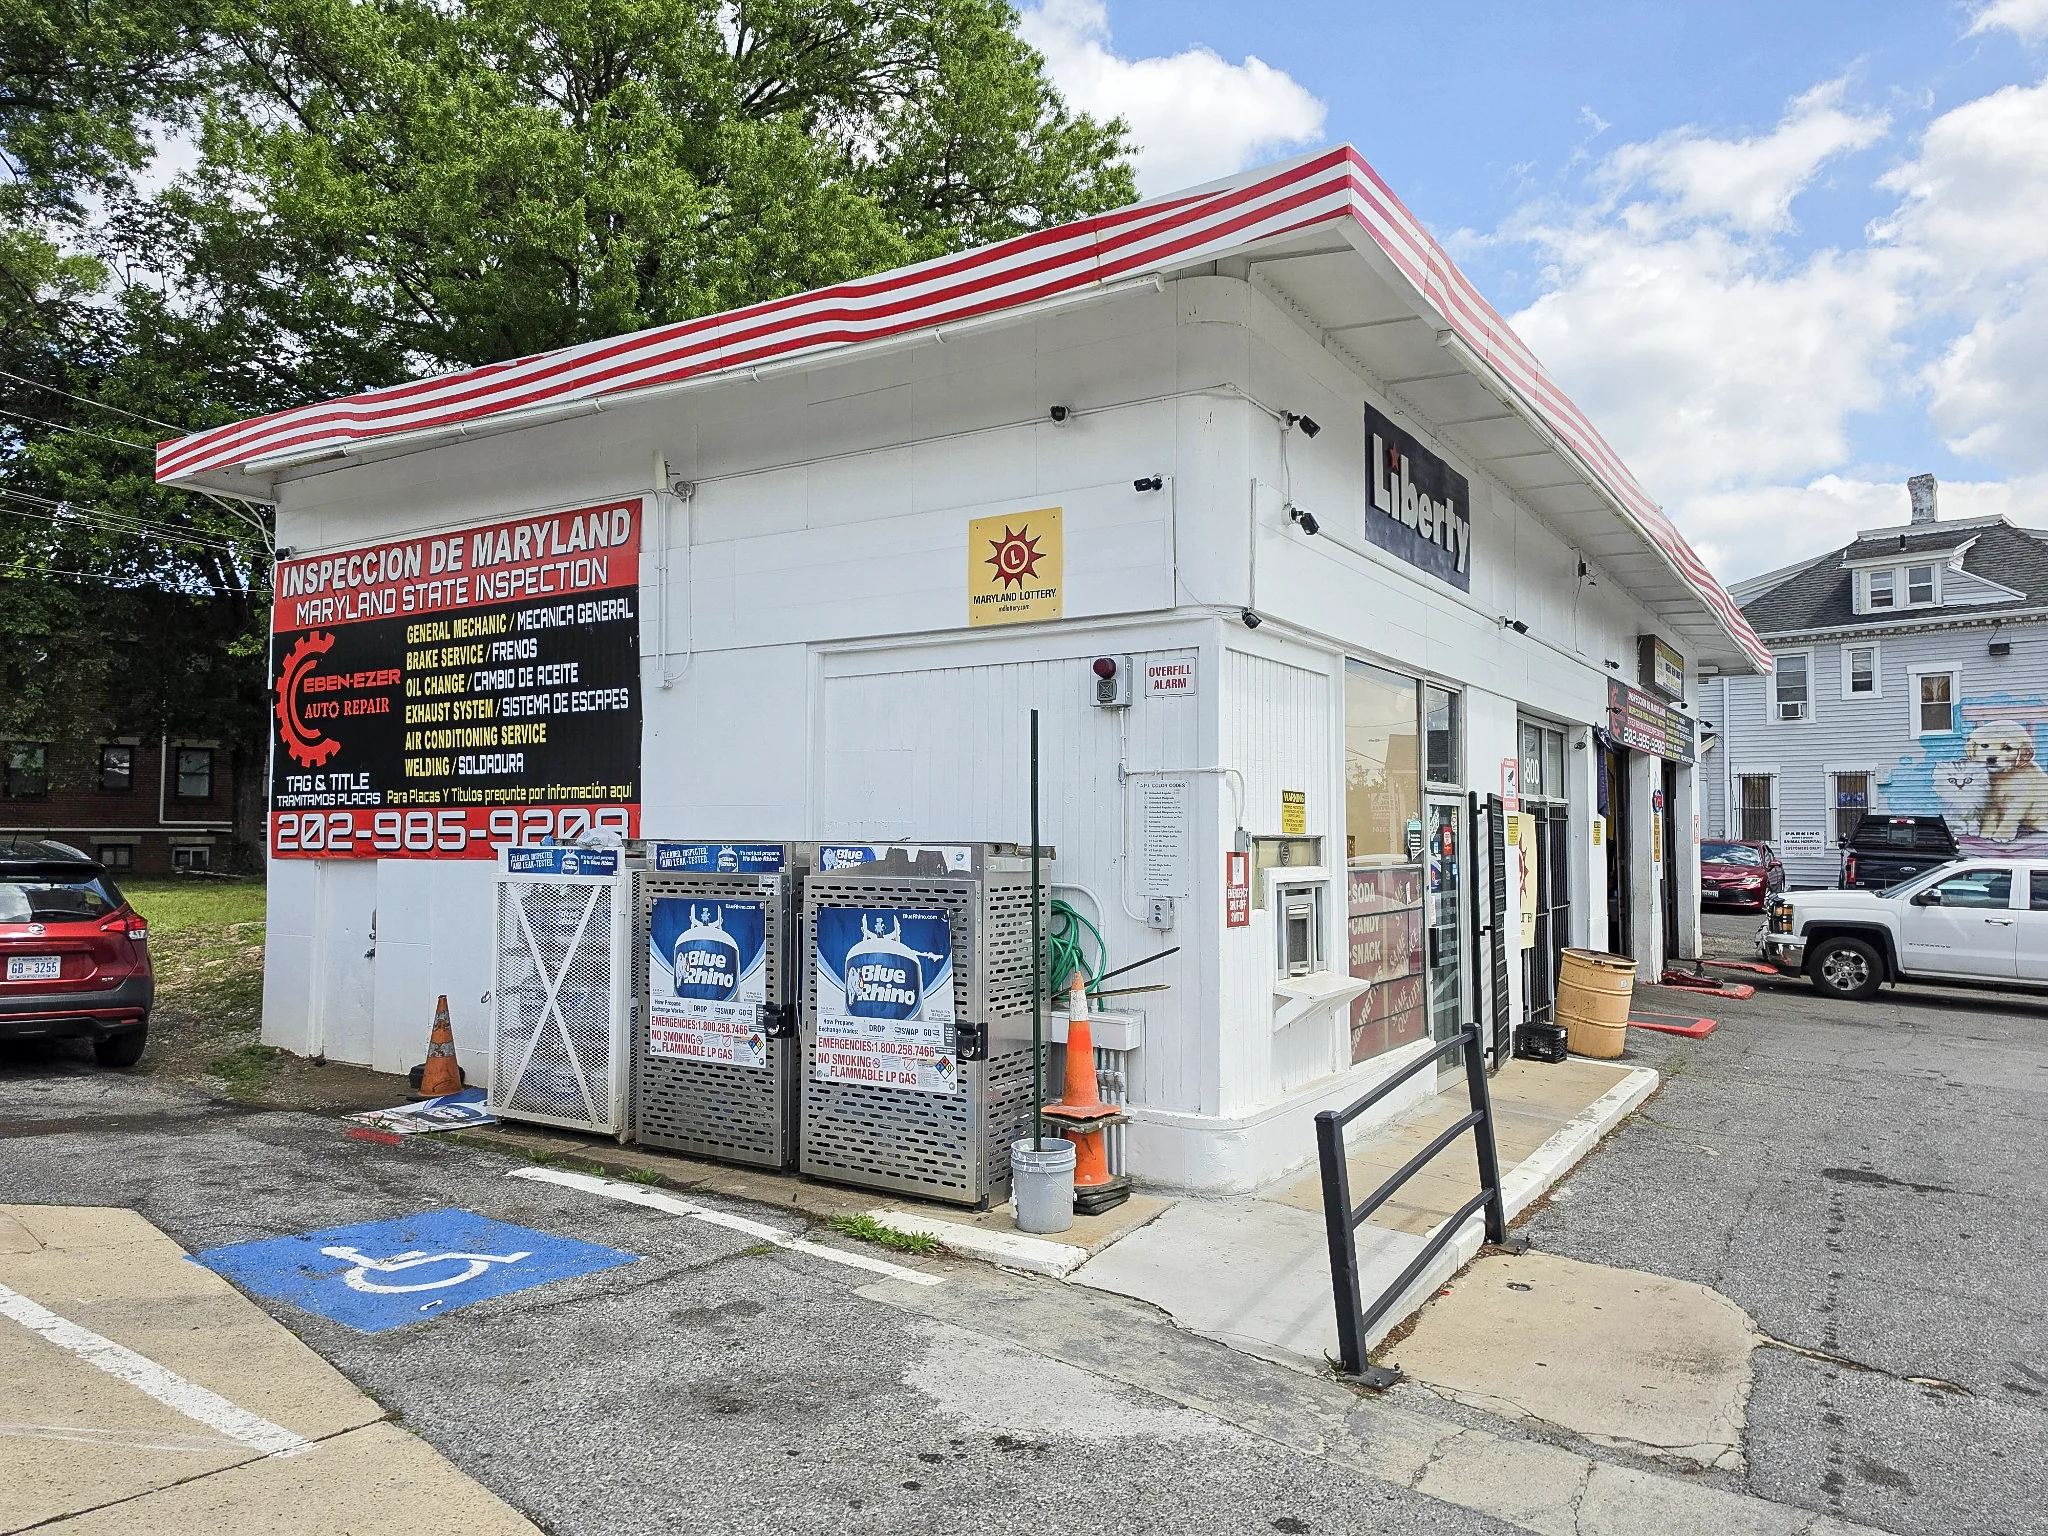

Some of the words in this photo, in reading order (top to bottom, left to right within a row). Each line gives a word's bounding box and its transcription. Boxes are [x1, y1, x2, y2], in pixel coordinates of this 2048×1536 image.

[1373, 432, 1470, 574] Liberty
[282, 543, 422, 598] INSPECCION
[429, 537, 464, 574] DE
[471, 508, 632, 568] MARYLAND
[296, 588, 397, 626] MARYLAND
[402, 577, 469, 611] STATE
[475, 556, 608, 602] INSPECTION
[973, 593, 1017, 605] MARYLAND
[406, 620, 451, 644] GENERAL
[453, 613, 507, 639] MECHANIC
[517, 604, 574, 631] MECANICA
[577, 597, 634, 624] GENERAL
[406, 649, 439, 671] BRAKE
[441, 644, 484, 667] SERVICE
[303, 668, 401, 693] EBEN-EZER
[406, 677, 422, 698] OIL
[424, 673, 465, 696] CHANGE
[518, 666, 534, 688] DE
[537, 662, 579, 686] ACEITE
[1148, 664, 1192, 678] OVERFILL
[1153, 677, 1187, 690] ALARM
[304, 700, 340, 719] AUTO
[343, 697, 390, 716] REPAIR
[405, 701, 451, 724] EXHAUST
[453, 698, 494, 721] SYSTEM
[553, 692, 569, 714] DE
[571, 687, 629, 712] ESCAPES
[405, 731, 422, 751] AIR
[424, 726, 498, 750] CONDITIONING
[501, 722, 547, 746] SERVICE
[404, 756, 450, 777] WELDING
[1525, 757, 1540, 785] 800
[286, 775, 312, 793] TAG
[315, 774, 327, 791] &
[329, 772, 370, 791] TITLE
[387, 789, 408, 804] Para
[409, 788, 441, 803] Placas
[442, 788, 450, 803] Y
[484, 784, 527, 805] pregunte
[528, 785, 546, 804] por
[547, 780, 607, 801] información
[276, 793, 336, 807] TRAMITAMOS
[337, 792, 381, 806] PLACAS
[836, 849, 864, 860] Blue
[1351, 882, 1376, 905] SODA
[1351, 915, 1380, 936] CANDY
[688, 950, 727, 968] Blue
[1352, 940, 1382, 966] SNACK
[684, 967, 734, 988] Rhino
[861, 965, 906, 984] Blue
[857, 982, 916, 1006] Rhino
[720, 1007, 736, 1015] SWAP
[651, 1030, 662, 1041] NO
[663, 1030, 696, 1045] SMOKING
[868, 1024, 886, 1033] DROP
[901, 1027, 919, 1036] SWAP
[923, 1028, 932, 1037] GO
[662, 1041, 706, 1057] FLAMMABLE
[707, 1046, 716, 1058] LP
[717, 1047, 733, 1060] GAS
[818, 1052, 830, 1064] NO
[832, 1053, 872, 1069] SMOKING
[830, 1065, 884, 1082] FLAMMABLE
[885, 1070, 897, 1083] LP
[898, 1072, 917, 1085] GAS
